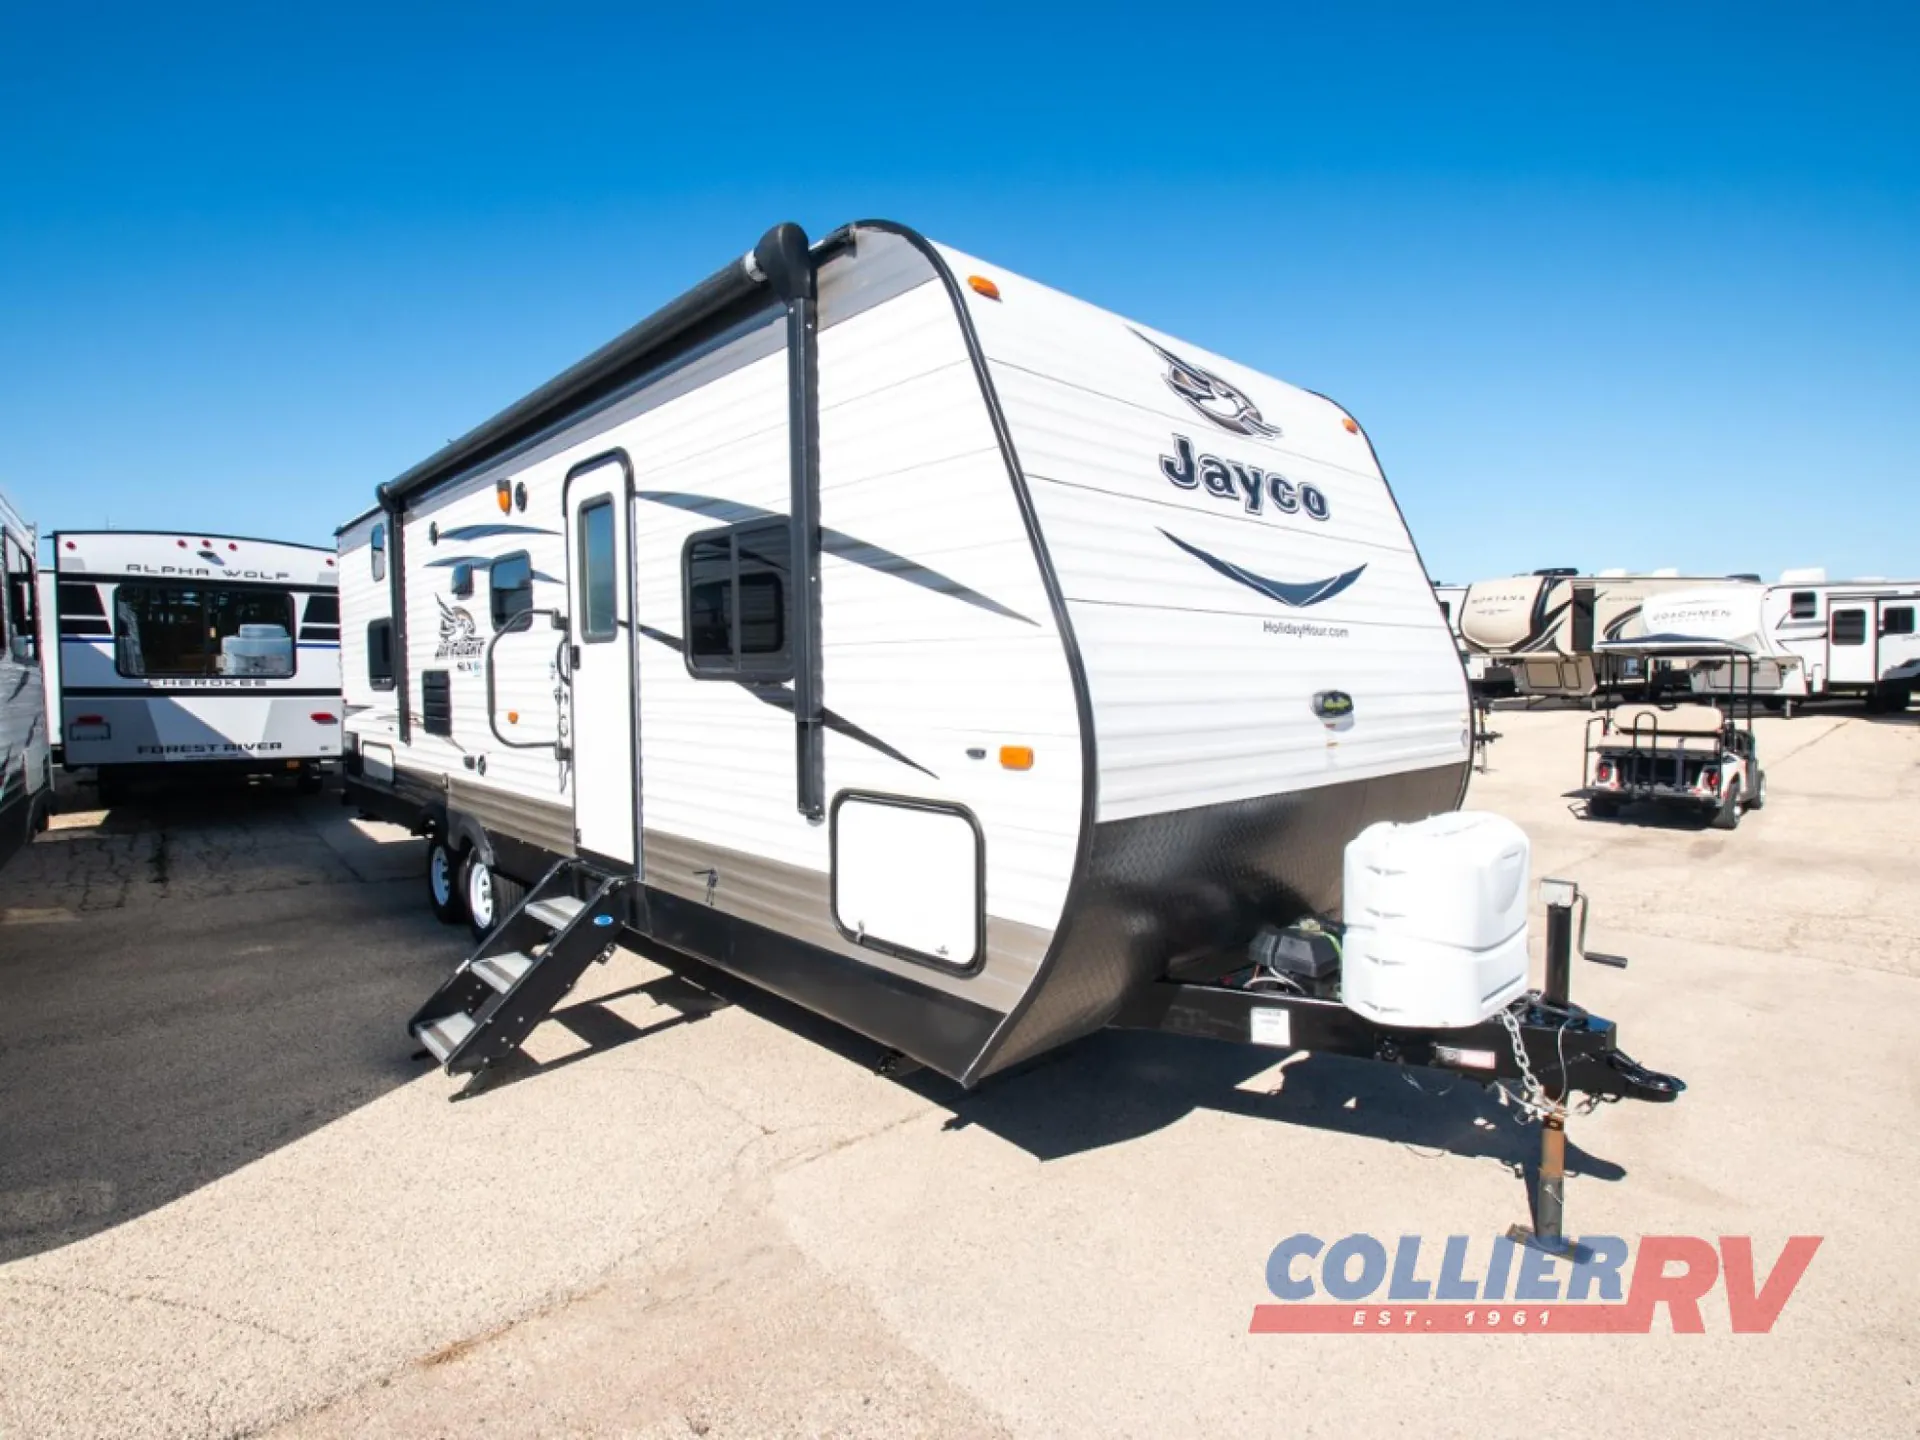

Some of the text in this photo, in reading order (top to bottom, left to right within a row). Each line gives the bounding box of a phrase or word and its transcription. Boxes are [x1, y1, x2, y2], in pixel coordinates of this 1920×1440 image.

[1160, 434, 1329, 520] Jayco
[126, 563, 289, 579] ALPHA WOLF
[138, 742, 282, 755] FOREST RIVER
